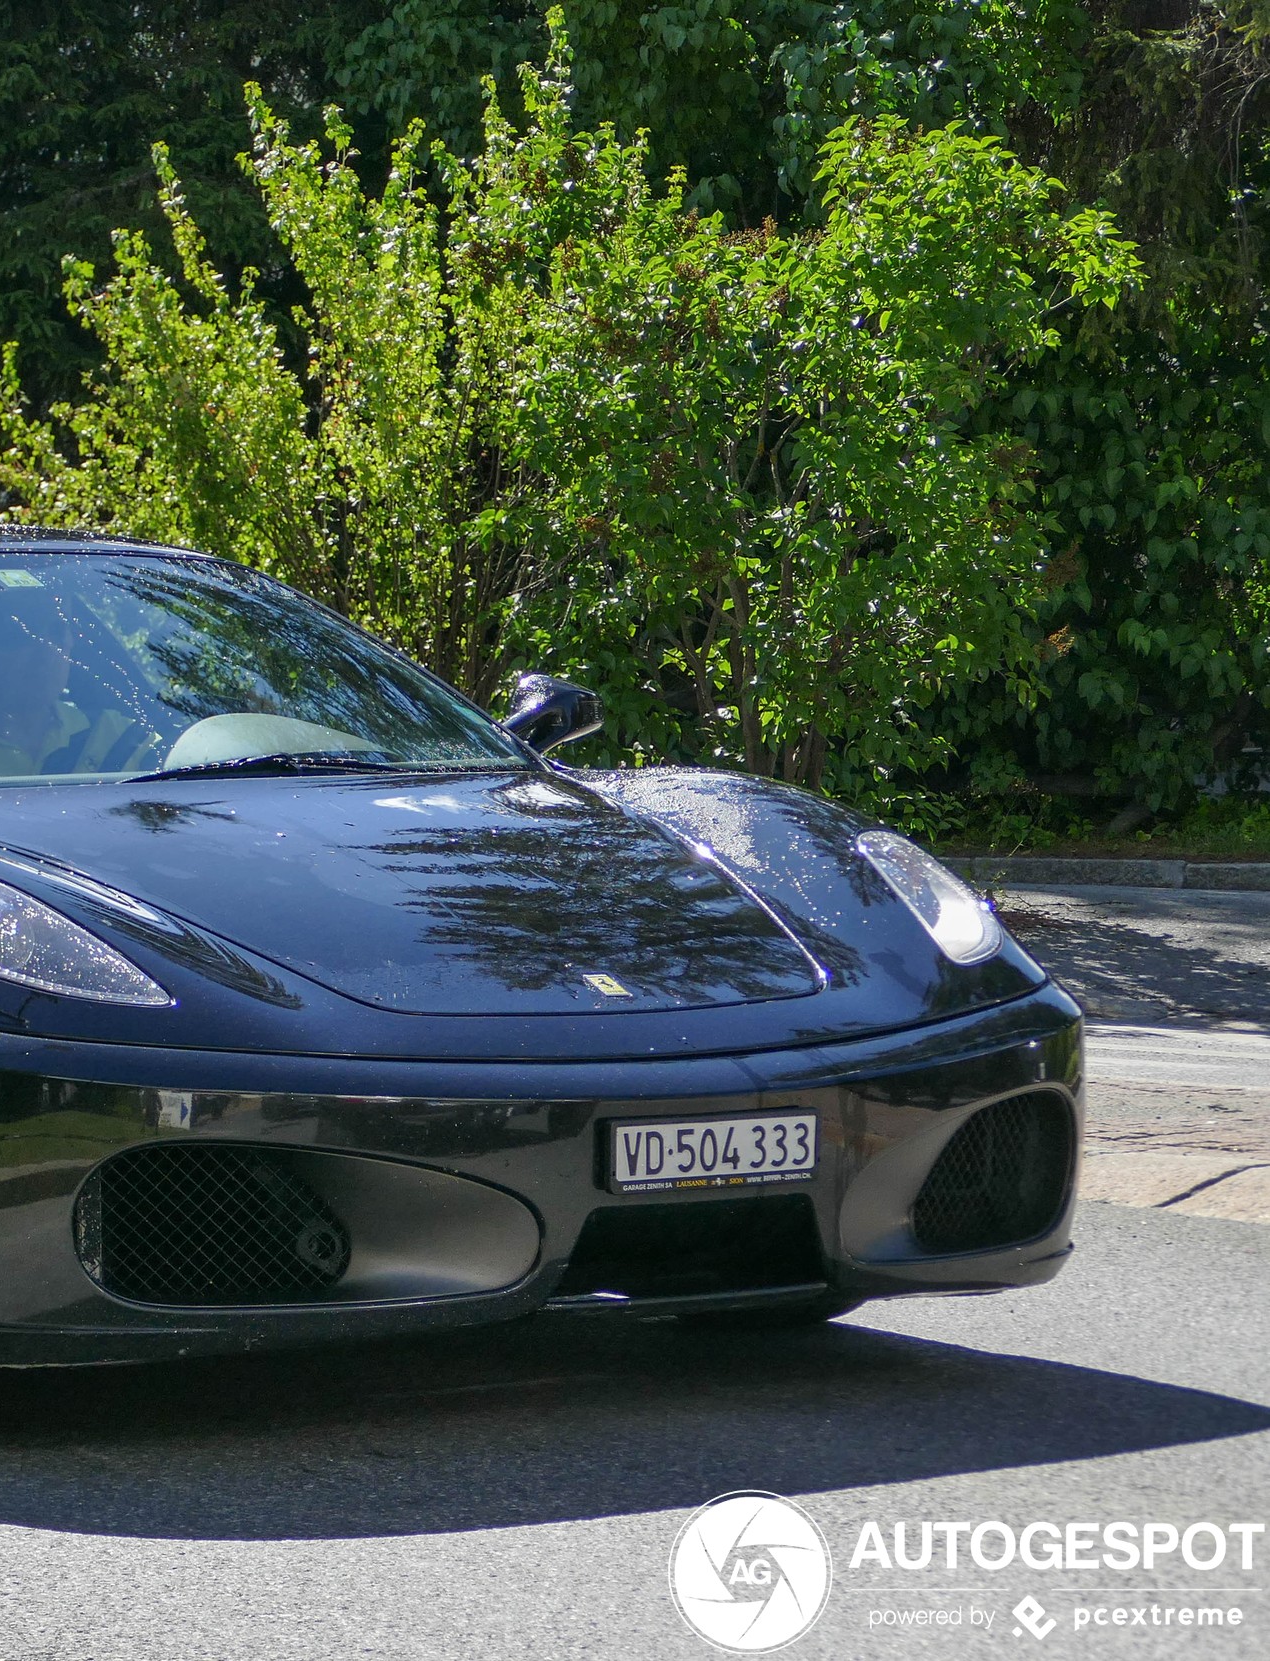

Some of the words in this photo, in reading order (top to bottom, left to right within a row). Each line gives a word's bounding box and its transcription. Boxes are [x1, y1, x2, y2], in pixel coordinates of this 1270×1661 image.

[750, 1123, 810, 1168] 333
[622, 1183, 647, 1192] GARAGE
[646, 1182, 664, 1190] ZENITH
[664, 1181, 673, 1189] SA
[676, 1179, 708, 1187] LAUSANNE
[728, 1177, 744, 1185] SION
